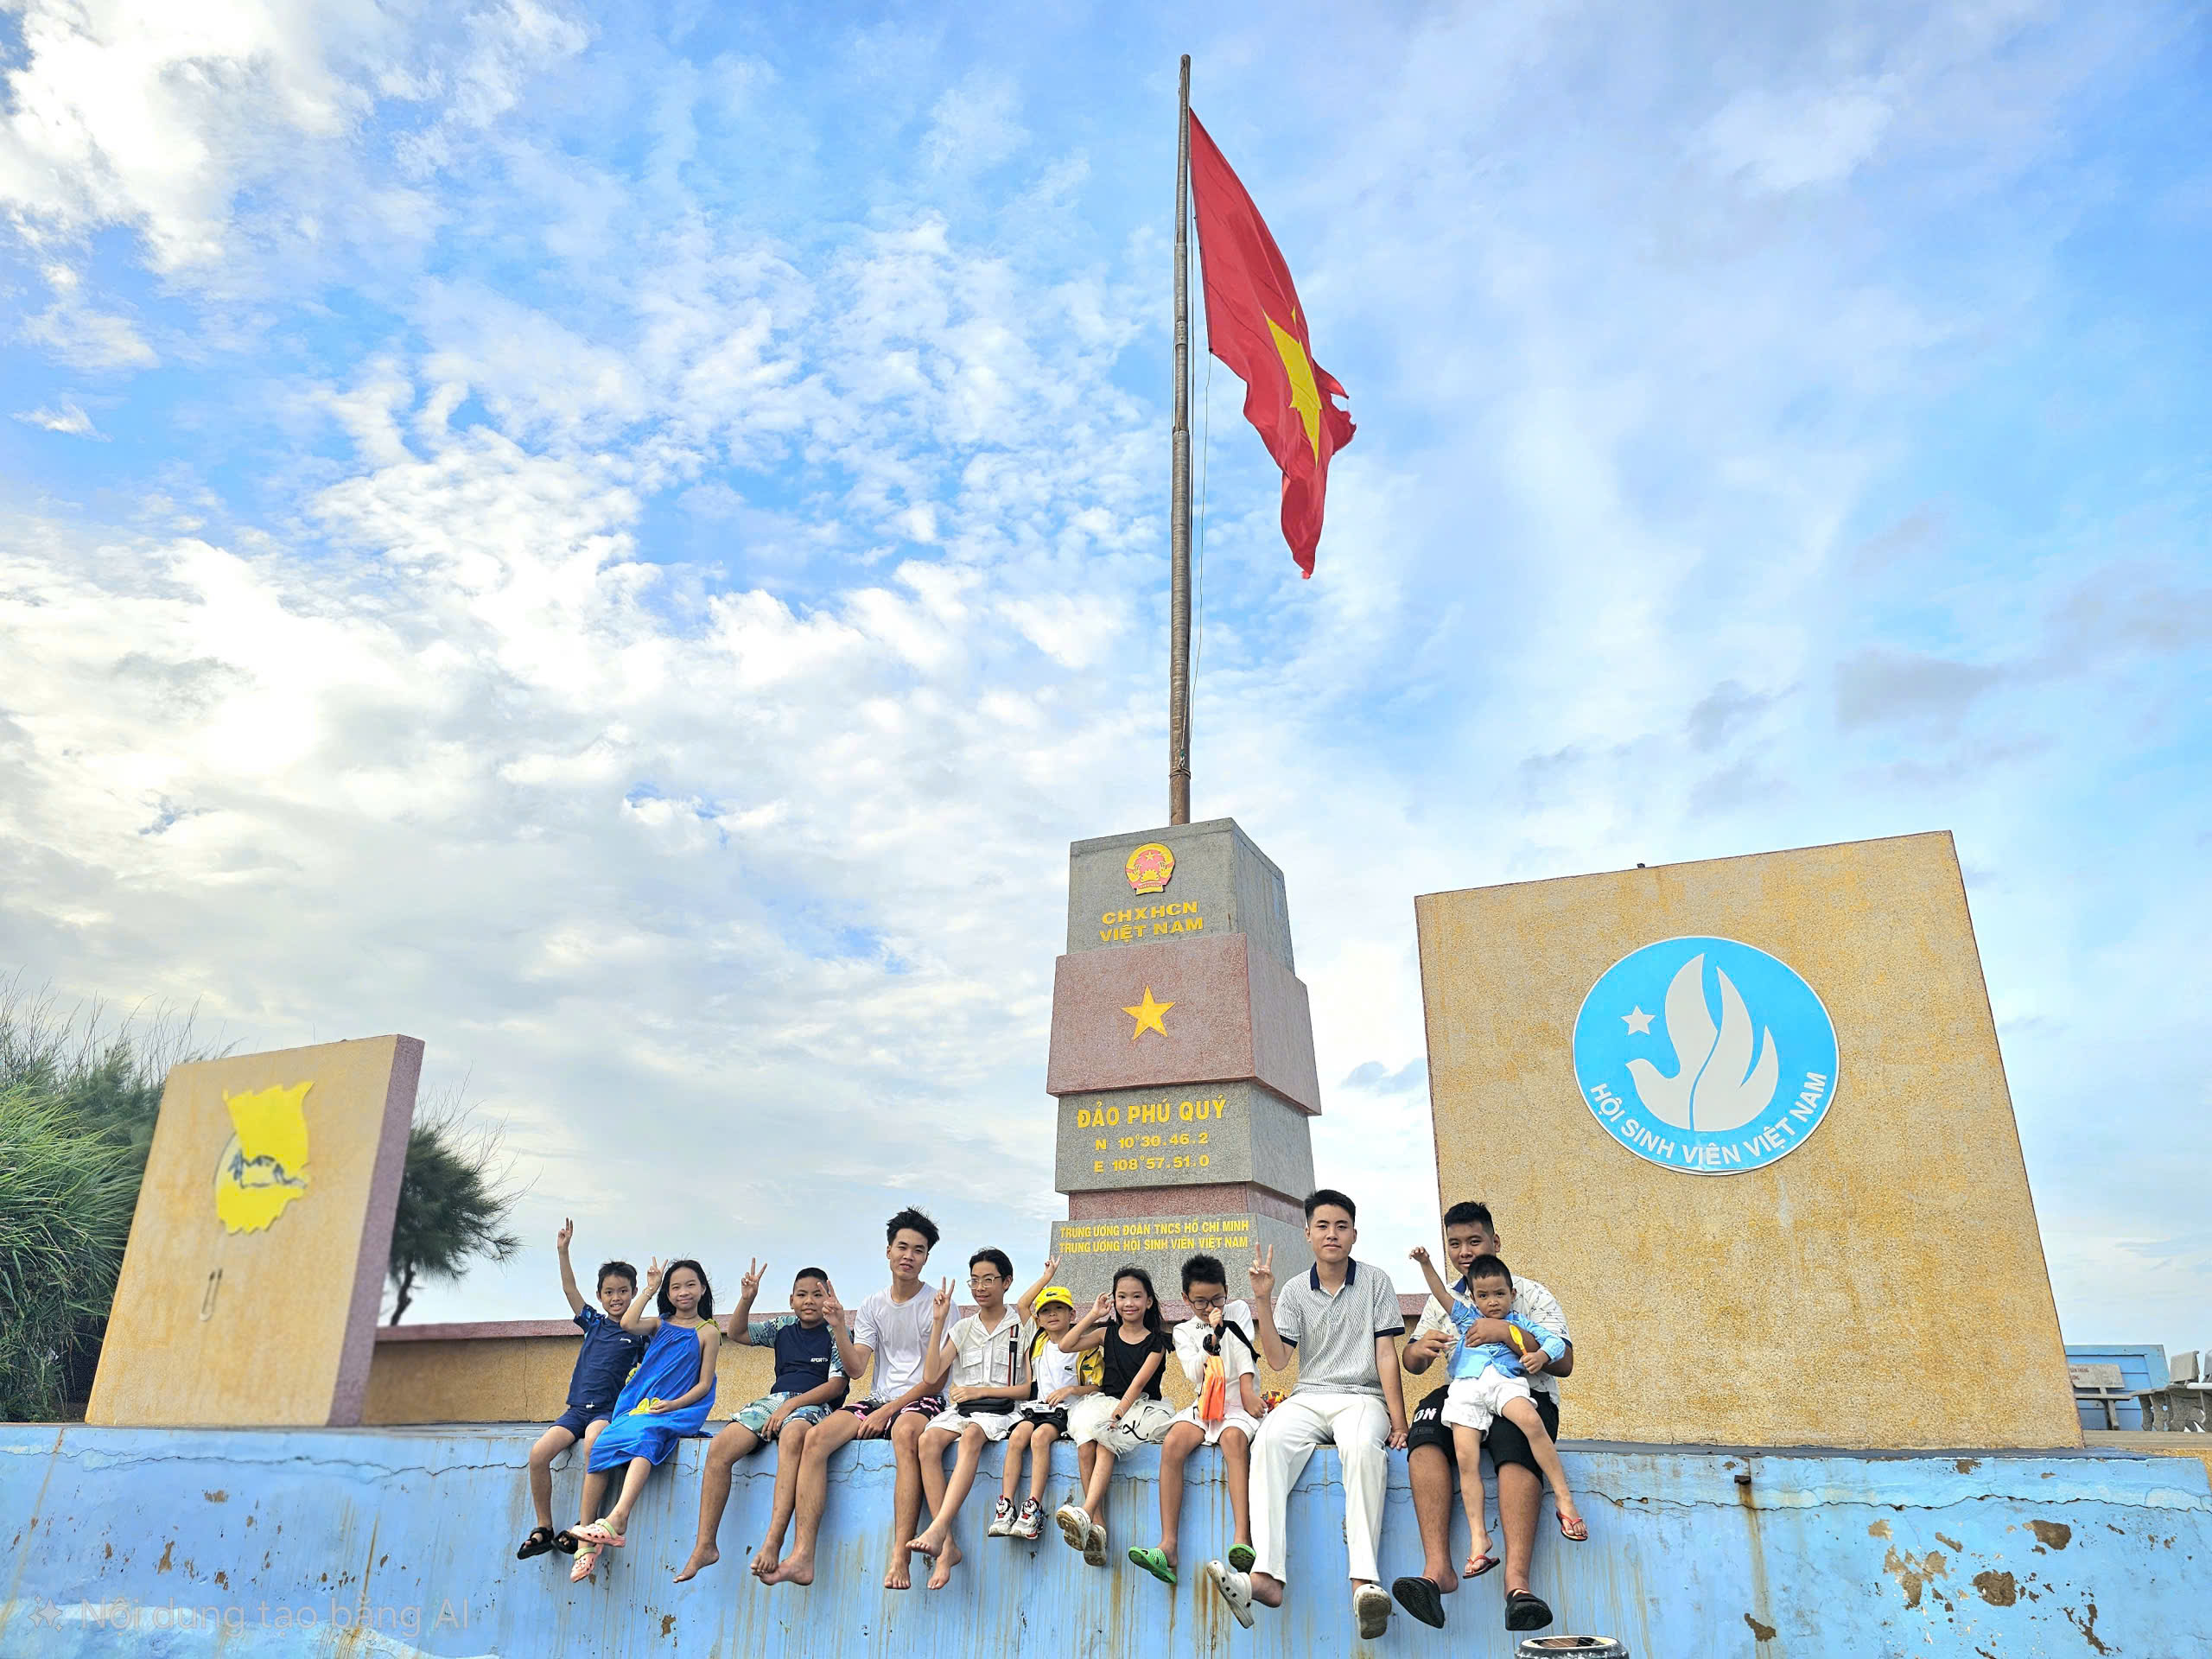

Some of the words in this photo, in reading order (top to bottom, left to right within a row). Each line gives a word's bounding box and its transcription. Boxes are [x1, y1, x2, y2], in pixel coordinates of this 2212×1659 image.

[1102, 900, 1198, 925] CHXHCN
[1099, 925, 1147, 943] VIỆT
[1154, 917, 1204, 936] NAM
[1077, 1100, 1120, 1128] ĐẢO
[1128, 1098, 1171, 1124] PHÚ
[1179, 1094, 1227, 1122] QUÝ
[1590, 1083, 1626, 1122] HỘI
[1621, 1119, 1675, 1159] SINH
[1681, 1142, 1741, 1165] VIÊN
[1743, 1117, 1796, 1158] VIỆT
[1789, 1071, 1827, 1123] NAM
[1095, 1138, 1107, 1151] N
[1094, 1160, 1104, 1173] E
[1060, 1226, 1091, 1238] TRUNG
[1122, 1222, 1151, 1236] ĐOÀN
[1154, 1223, 1181, 1234] TNCS
[1202, 1218, 1219, 1233] CHÍ
[1222, 1220, 1249, 1232] MINH
[1058, 1242, 1091, 1253] TRUNG
[1122, 1236, 1141, 1254] HỘI
[1144, 1239, 1168, 1250] SINH
[1172, 1236, 1195, 1249] VIÊN
[1198, 1236, 1222, 1250] VIỆT
[1224, 1236, 1249, 1248] NAM
